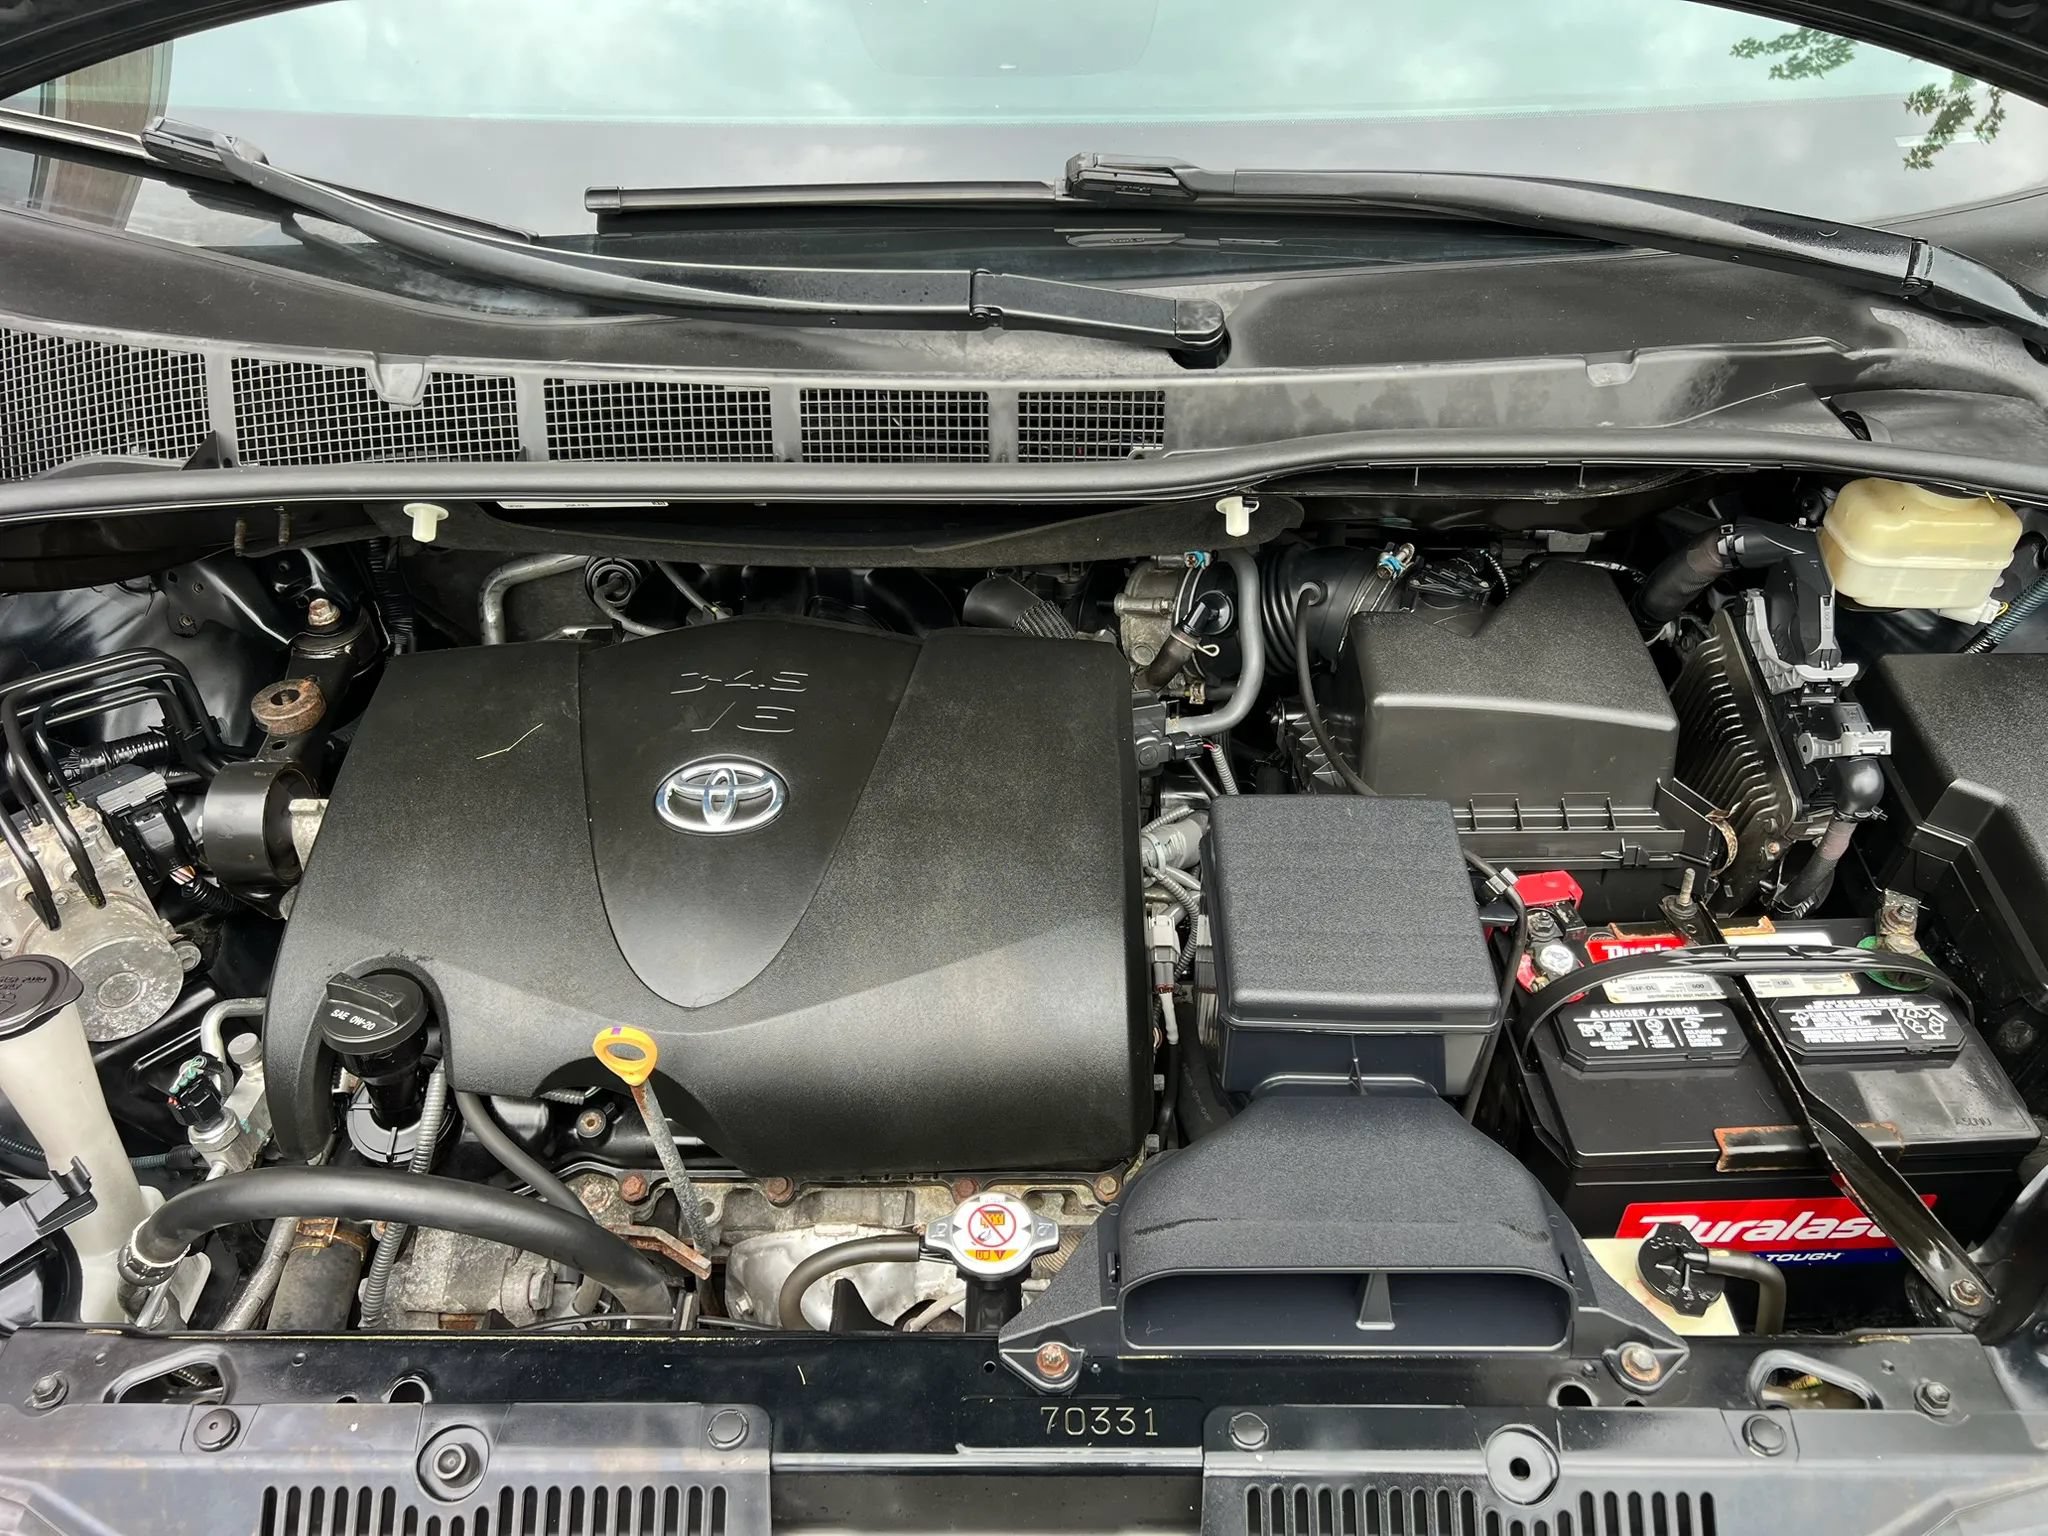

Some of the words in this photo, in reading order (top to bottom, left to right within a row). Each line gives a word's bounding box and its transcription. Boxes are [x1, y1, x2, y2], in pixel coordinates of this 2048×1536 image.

[330, 1008, 351, 1021] SAE
[348, 1015, 377, 1031] 0W-20
[1600, 1007, 1647, 1018] DANGER
[1656, 1006, 1700, 1016] POISON
[1765, 1252, 1842, 1263] TOUGH
[1040, 1405, 1160, 1436] 70331
